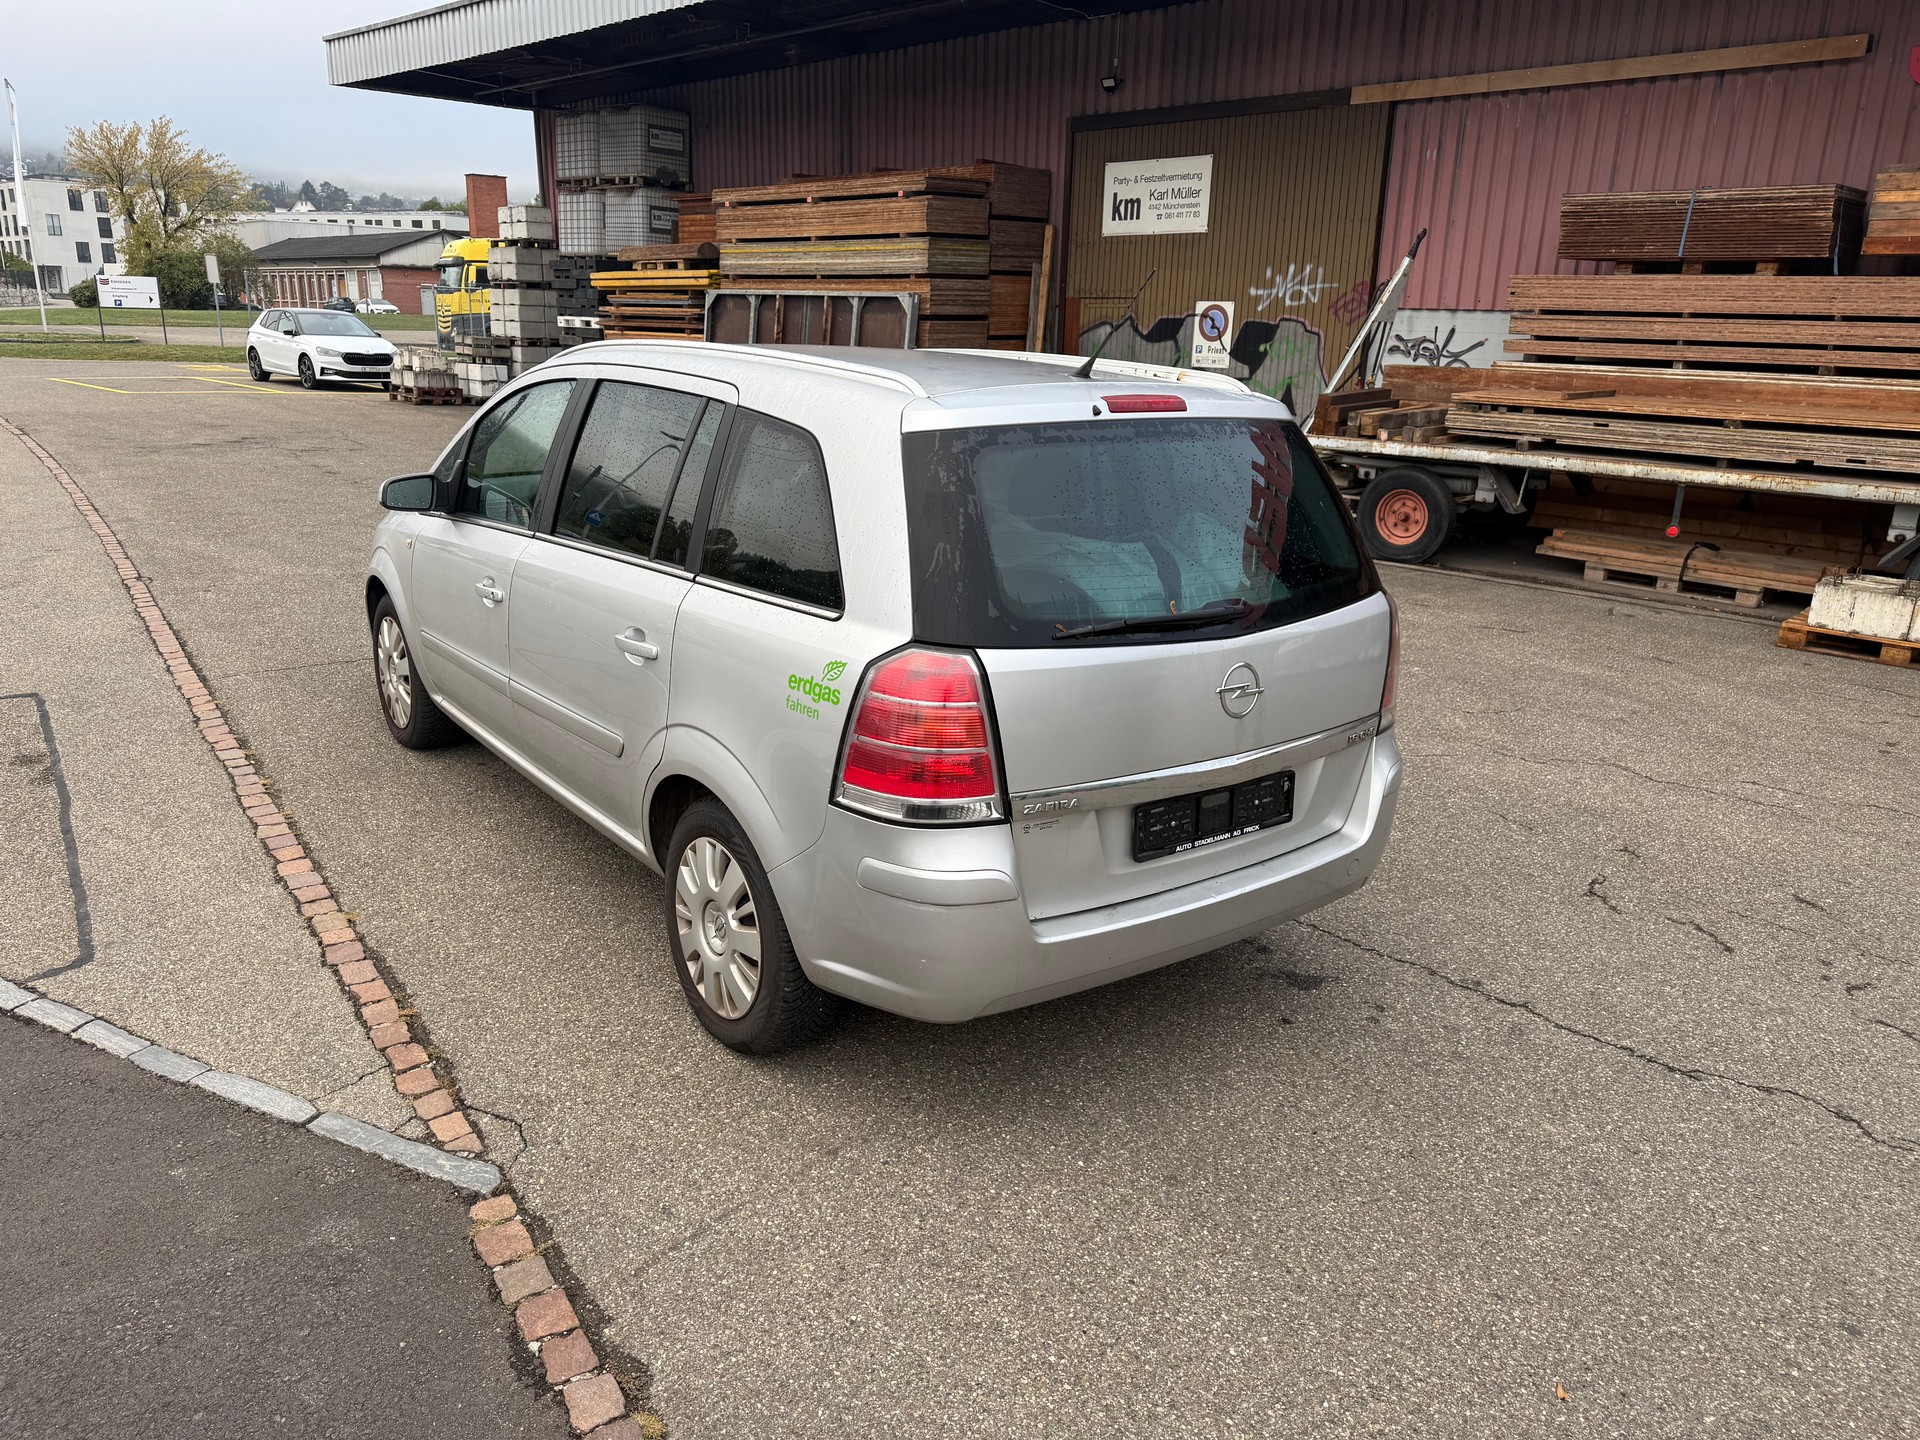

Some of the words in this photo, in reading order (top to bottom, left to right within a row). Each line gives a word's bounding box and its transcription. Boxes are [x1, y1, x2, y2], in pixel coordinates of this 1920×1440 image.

[1113, 176, 1133, 187] Party-
[1133, 175, 1139, 184] &
[1139, 171, 1203, 184] Festzeltvermietung
[1149, 188, 1169, 201] Karl
[1170, 186, 1203, 200] Müller
[1111, 191, 1142, 222] km
[1148, 203, 1162, 211] 4142
[1164, 212, 1175, 220] 061
[1192, 210, 1201, 218] 83
[788, 674, 841, 706] erdgas
[786, 694, 820, 721] fahren
[1023, 798, 1079, 814] ZAFIRA
[1175, 843, 1192, 852] AUTO
[1194, 832, 1231, 847] STADELMANN
[1232, 829, 1241, 837] AG
[1243, 824, 1260, 834] FRICK
